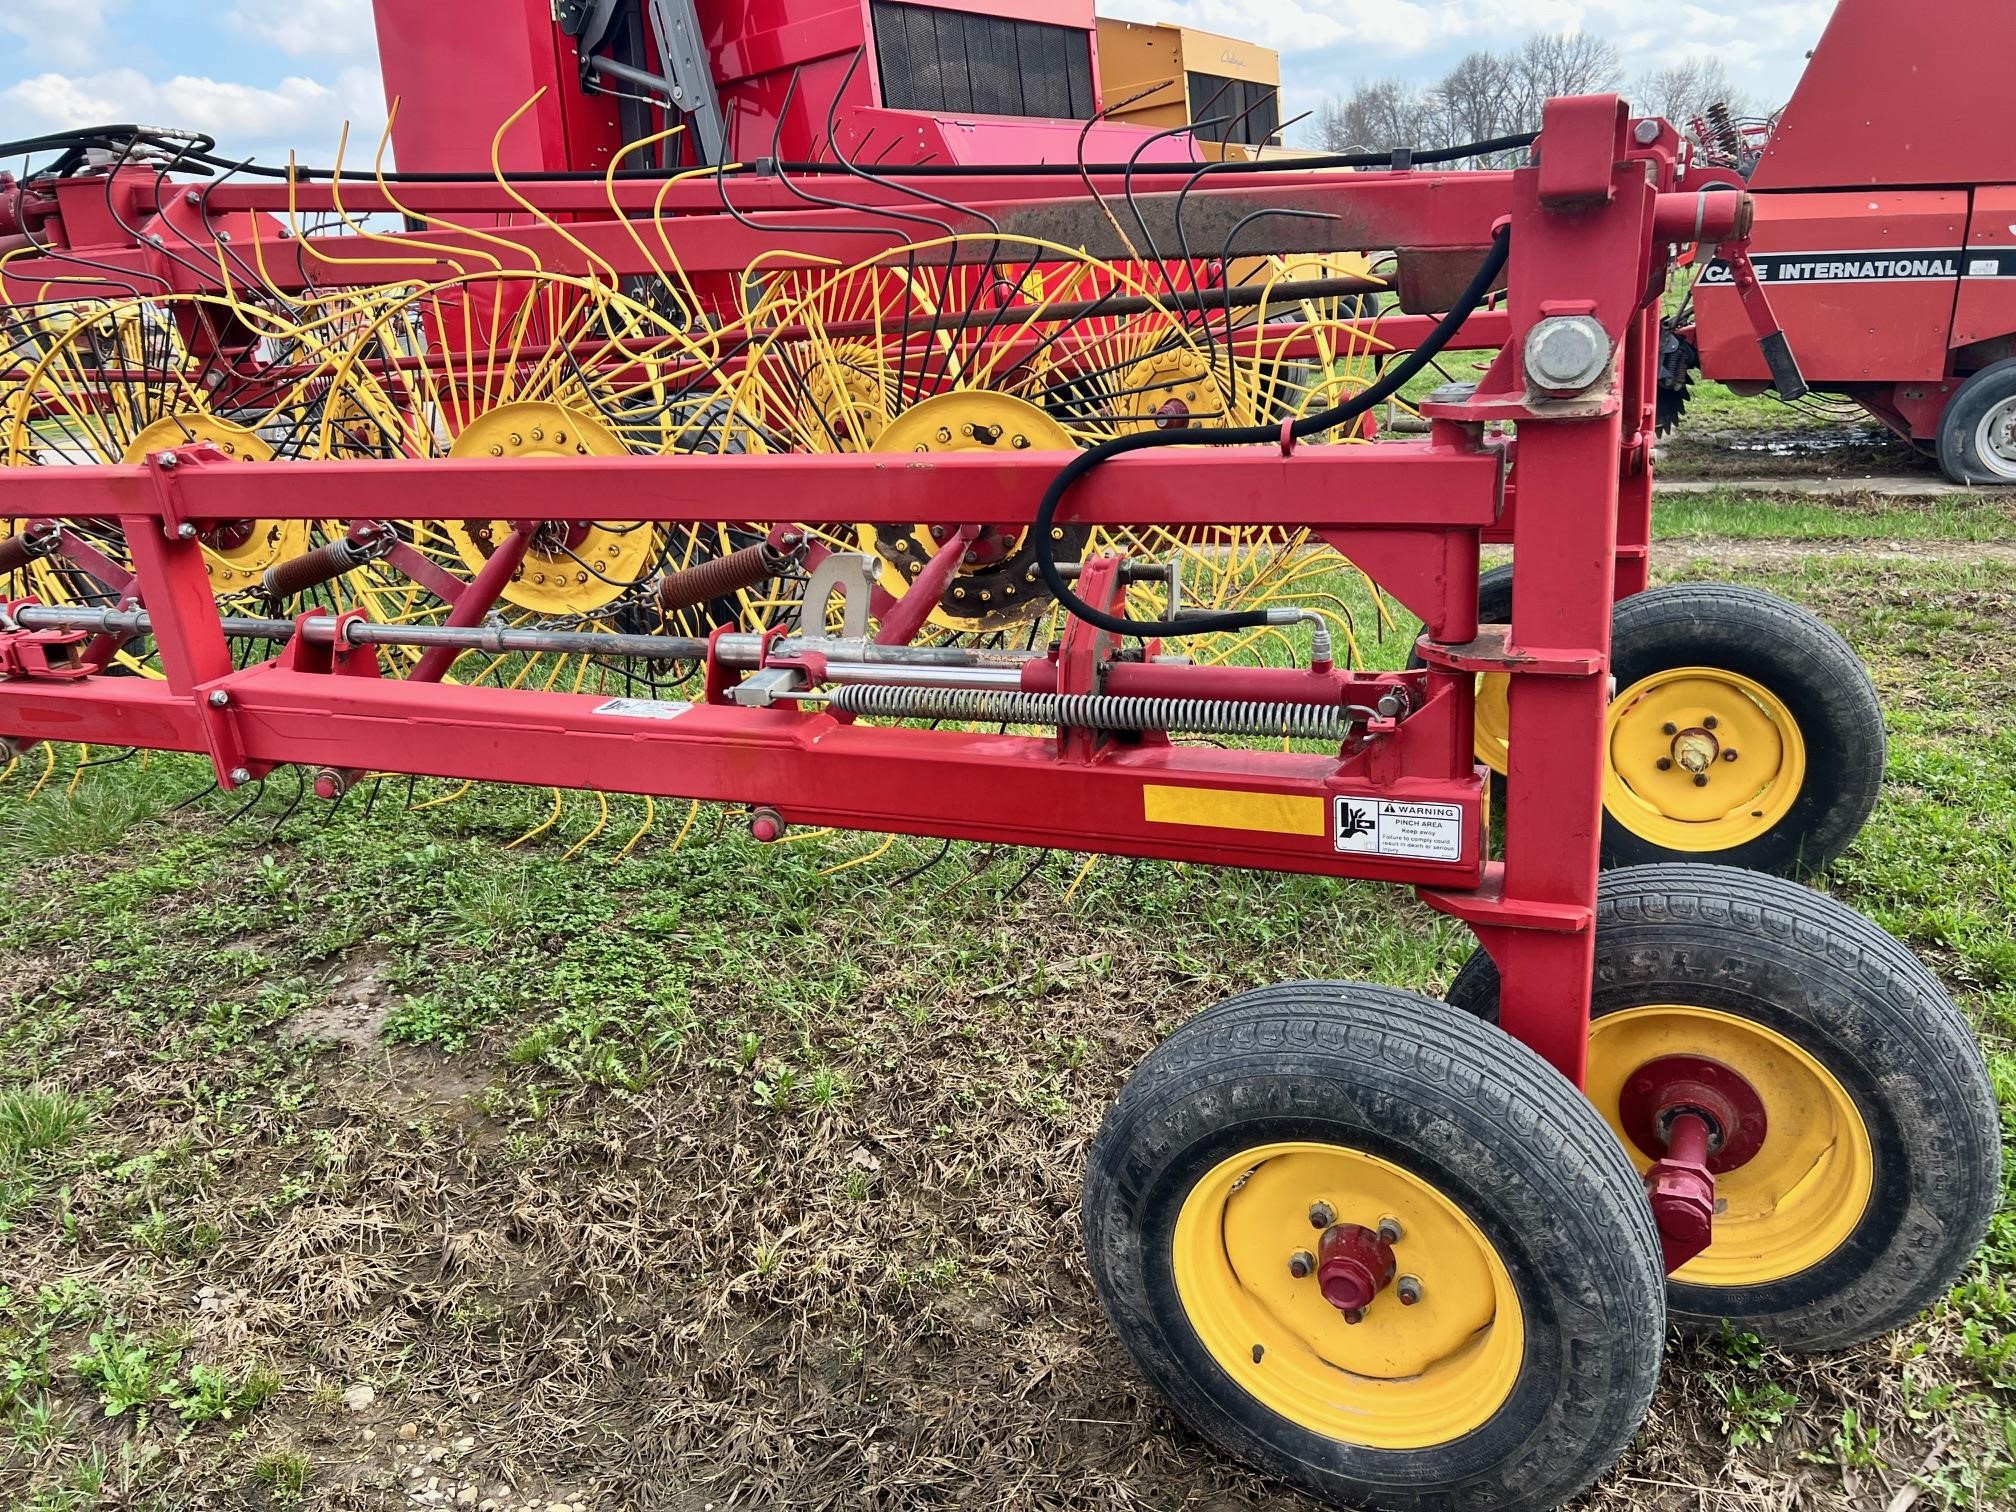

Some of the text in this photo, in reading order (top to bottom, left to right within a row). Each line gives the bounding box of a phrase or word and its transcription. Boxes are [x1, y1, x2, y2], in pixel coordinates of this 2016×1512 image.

[1705, 260, 1957, 281] CAE INTERNATIONAL
[1398, 806, 1454, 816] WARNING
[1401, 828, 1418, 836] Keep
